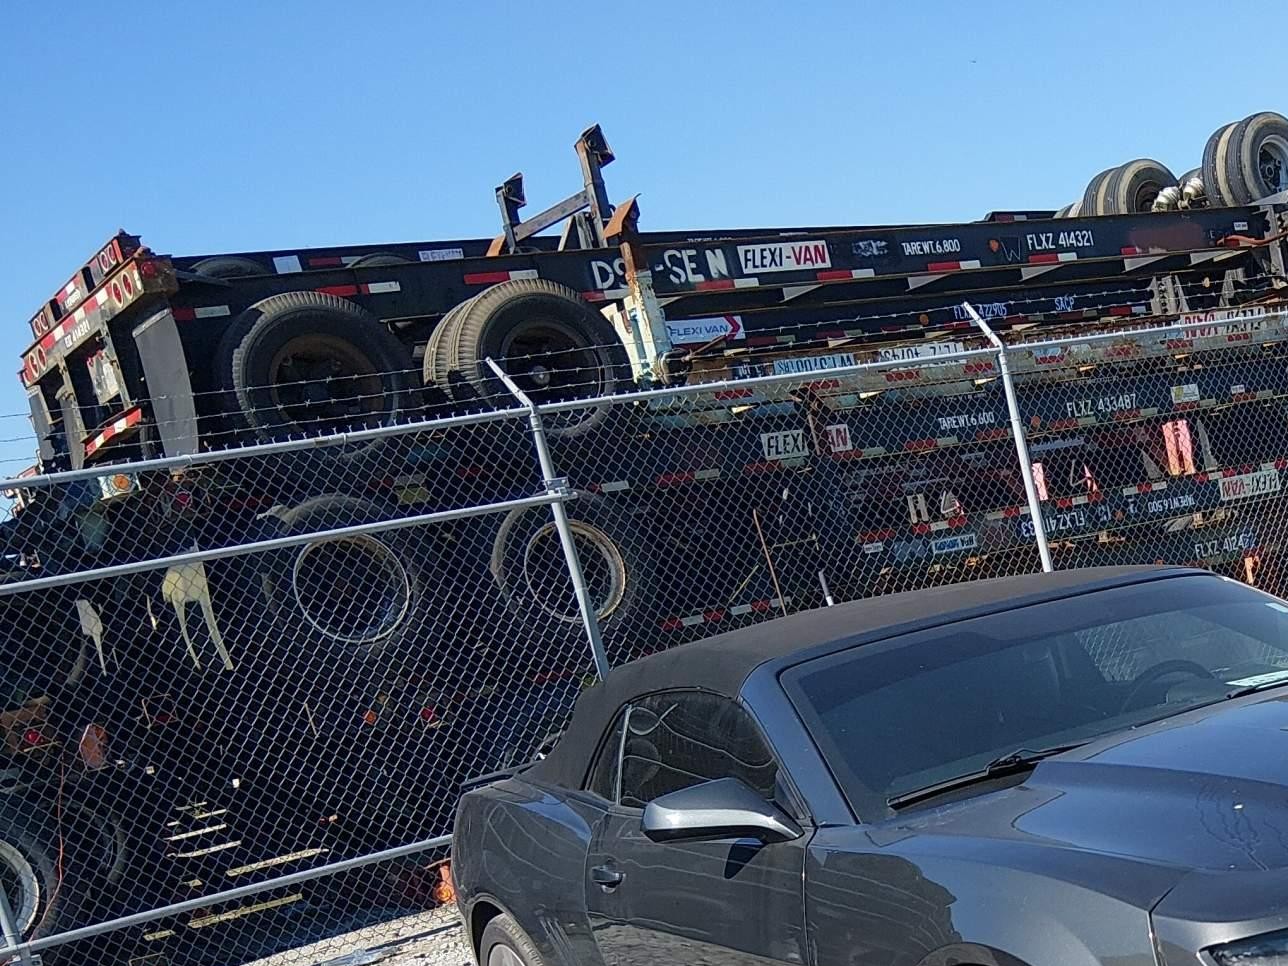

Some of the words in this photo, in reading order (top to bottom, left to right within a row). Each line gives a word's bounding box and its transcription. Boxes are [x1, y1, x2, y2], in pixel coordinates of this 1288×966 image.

[1026, 233, 1056, 250] FLXZ
[1058, 230, 1094, 248] 414321
[743, 244, 828, 269] FLEXI-VAN
[670, 327, 702, 336] FLEXI
[704, 325, 728, 334] VAN
[1066, 399, 1094, 417] FLXZ
[1098, 393, 1136, 412] 433487
[1194, 540, 1220, 559] FLXZ
